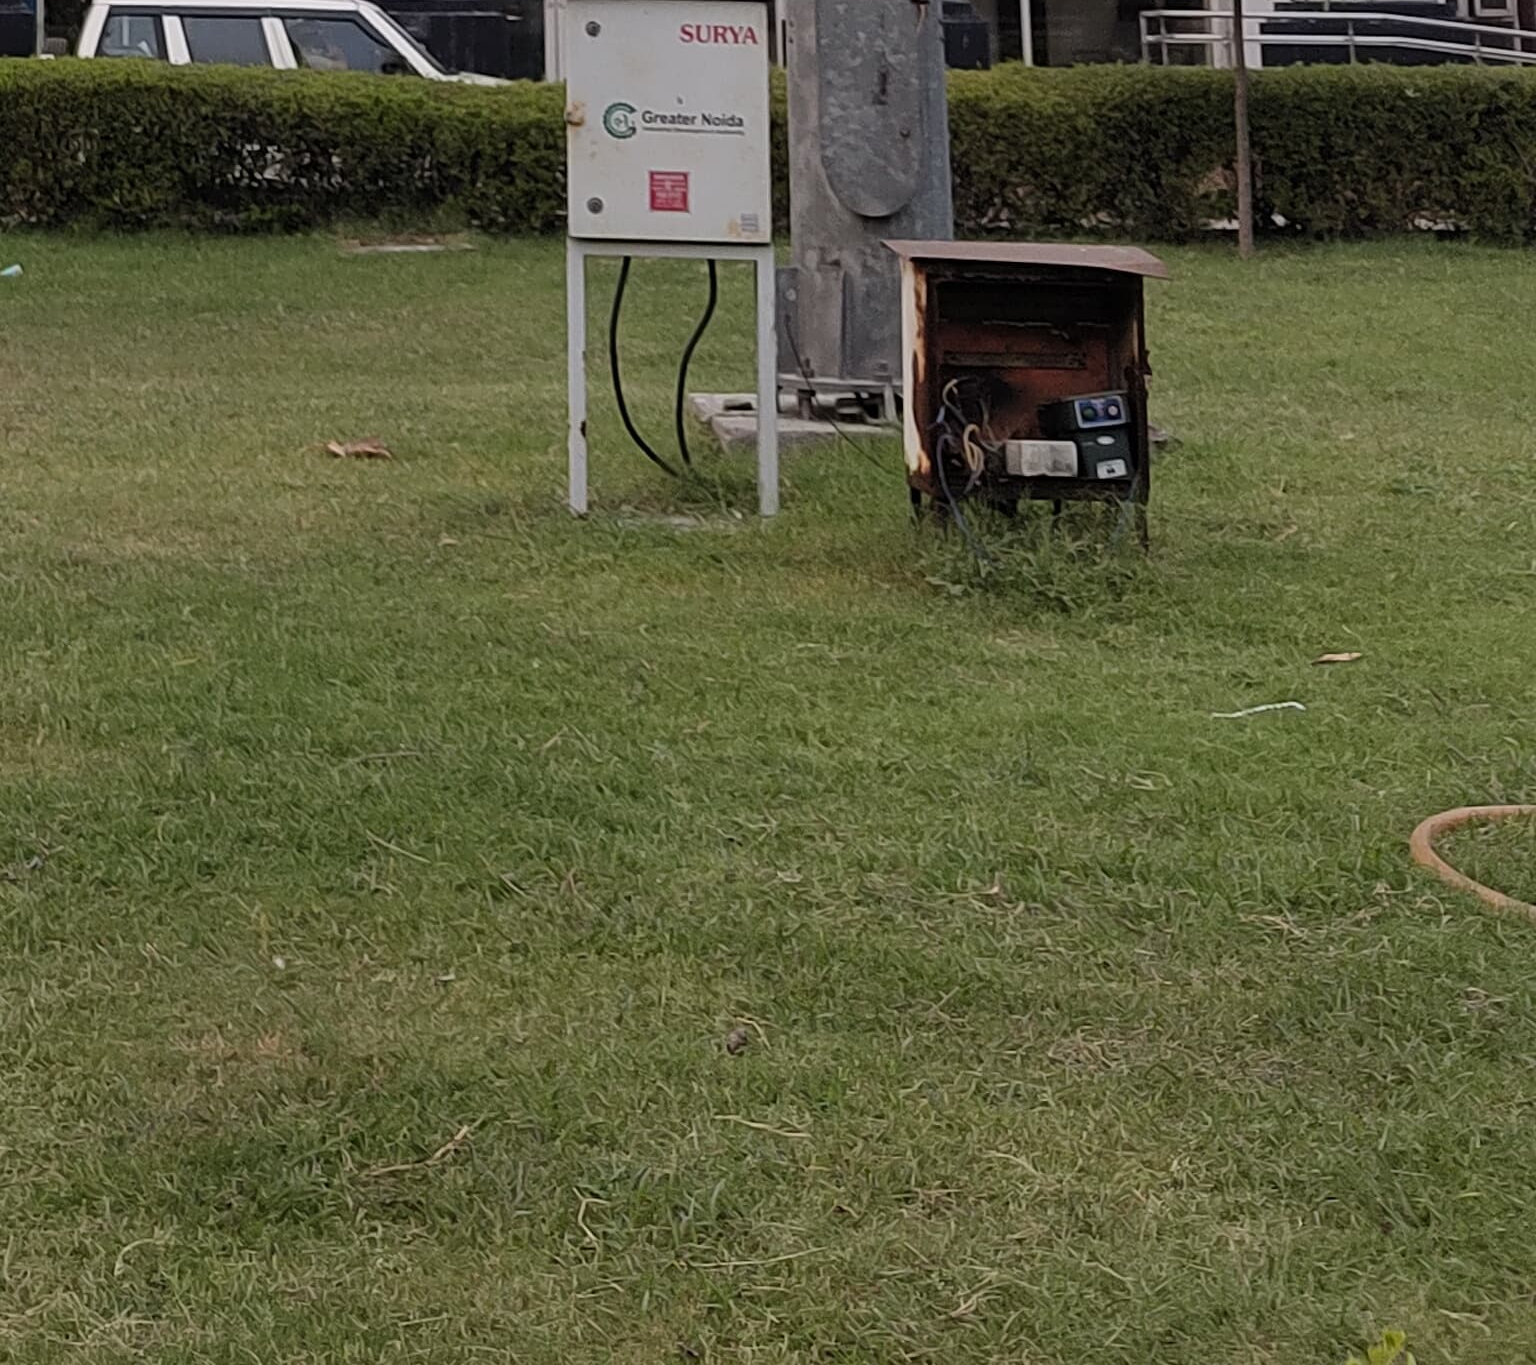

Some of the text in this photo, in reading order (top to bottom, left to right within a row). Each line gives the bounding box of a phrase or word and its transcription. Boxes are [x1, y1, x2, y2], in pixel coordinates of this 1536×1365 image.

[679, 24, 759, 45] SURYA
[642, 110, 745, 127] Greater Noida
